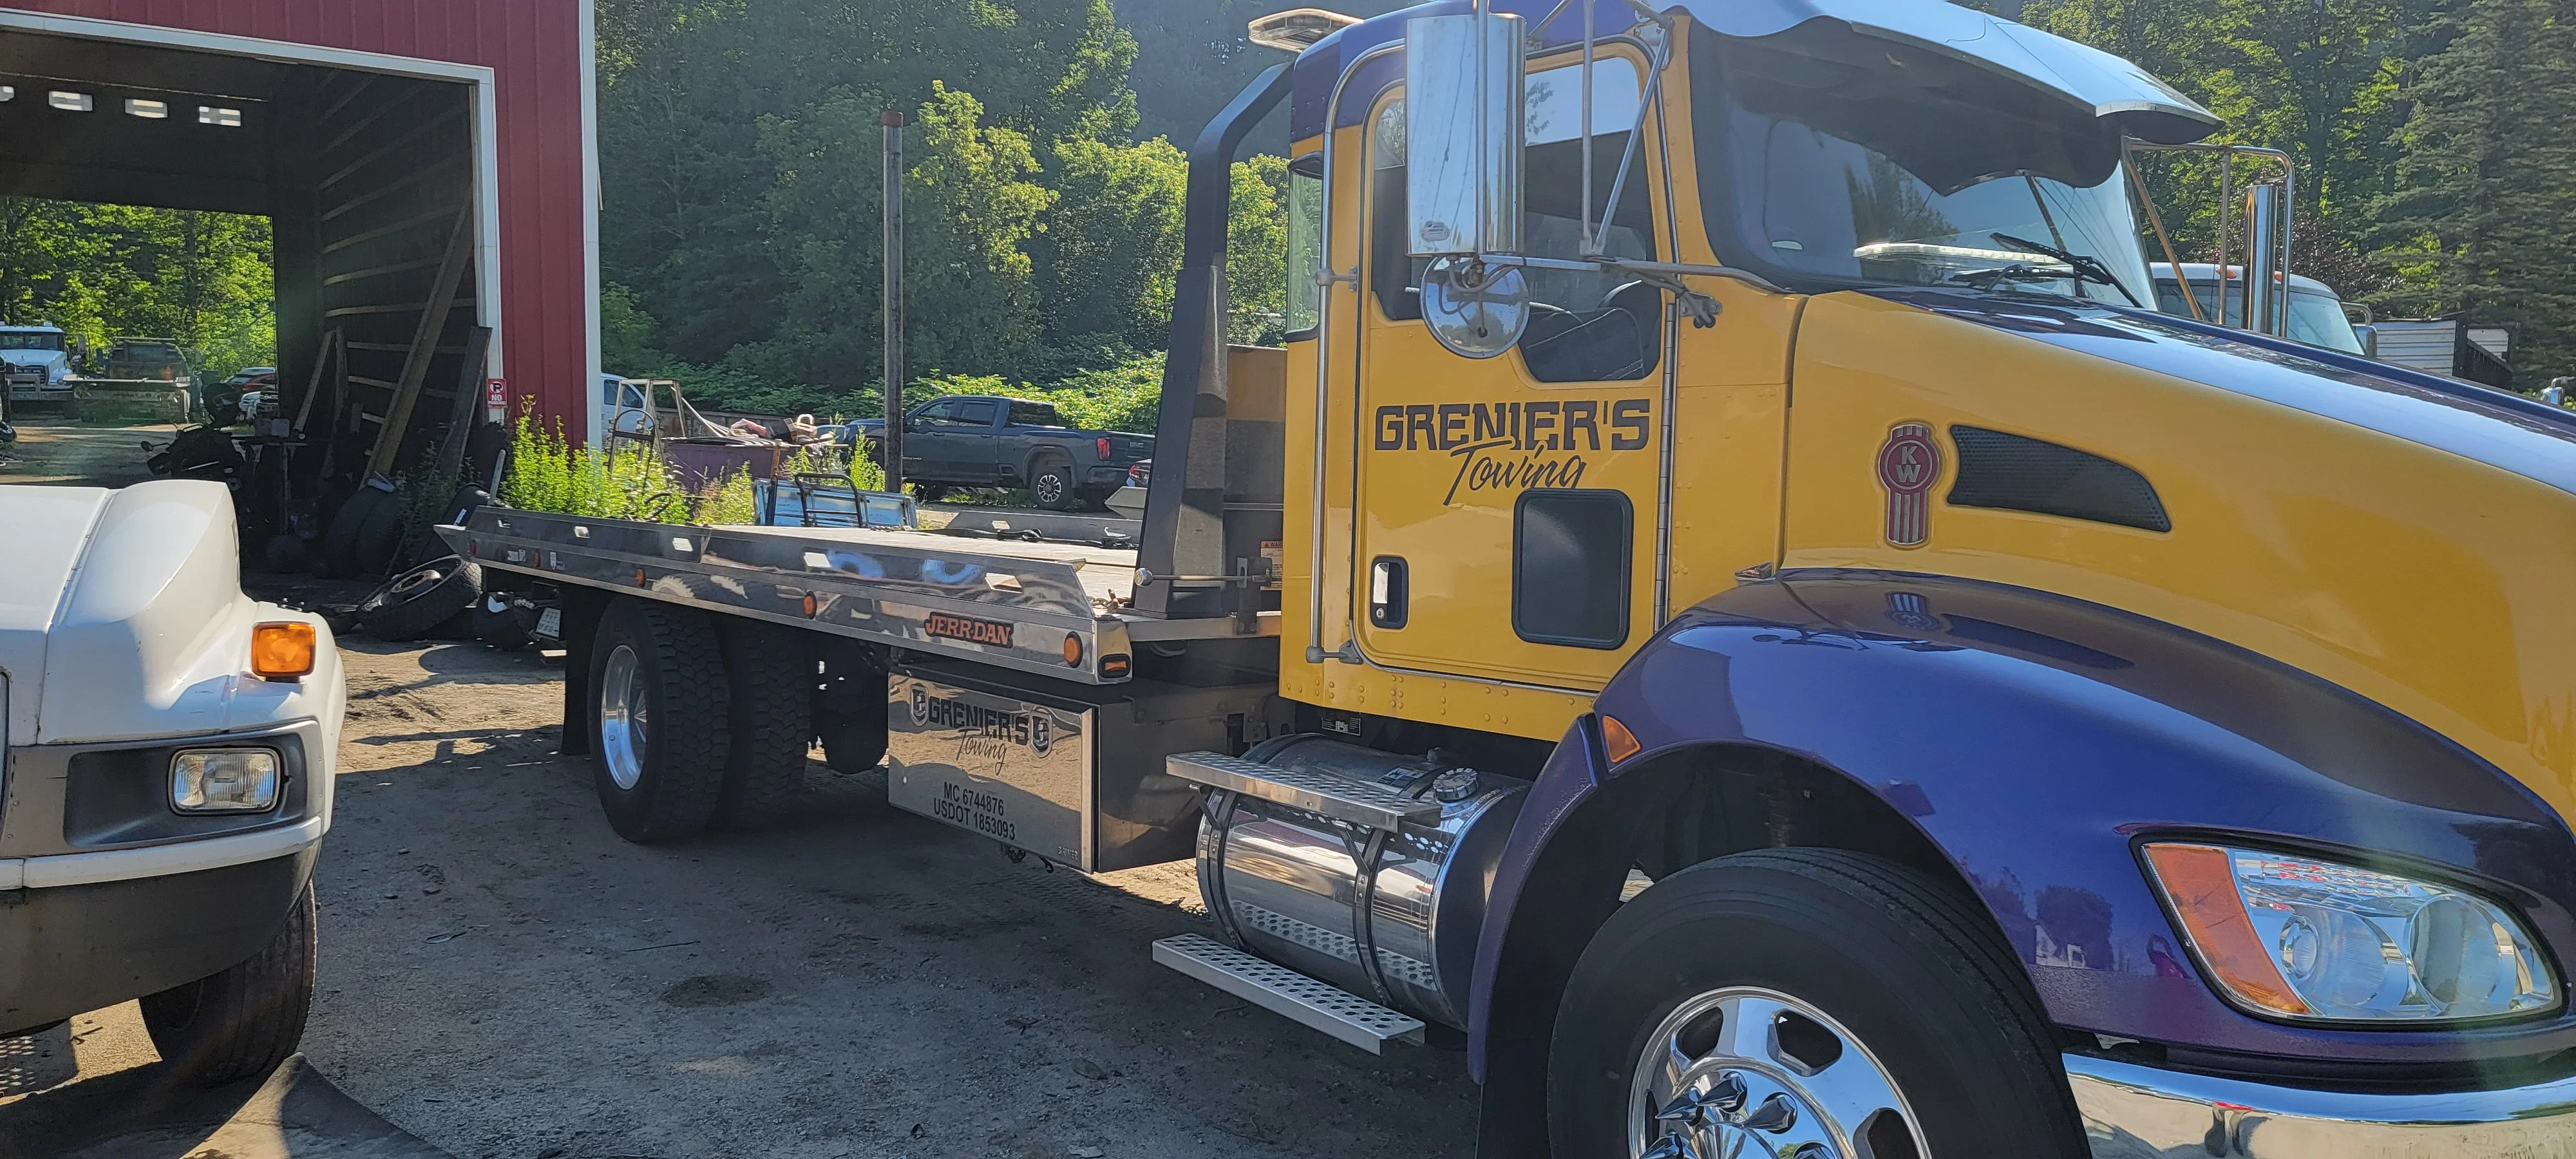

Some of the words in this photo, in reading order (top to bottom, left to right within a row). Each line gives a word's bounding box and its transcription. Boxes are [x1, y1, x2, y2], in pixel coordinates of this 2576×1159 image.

[1374, 399, 1651, 451] GRENIER'S
[1443, 440, 1587, 506] Towing
[929, 696, 1028, 746] GRENIER'S
[956, 728, 1007, 776] Towing
[934, 797, 971, 825] USDOT
[973, 812, 1015, 840] 1853093
[943, 781, 960, 803] MC
[963, 788, 1004, 816] 6744876
